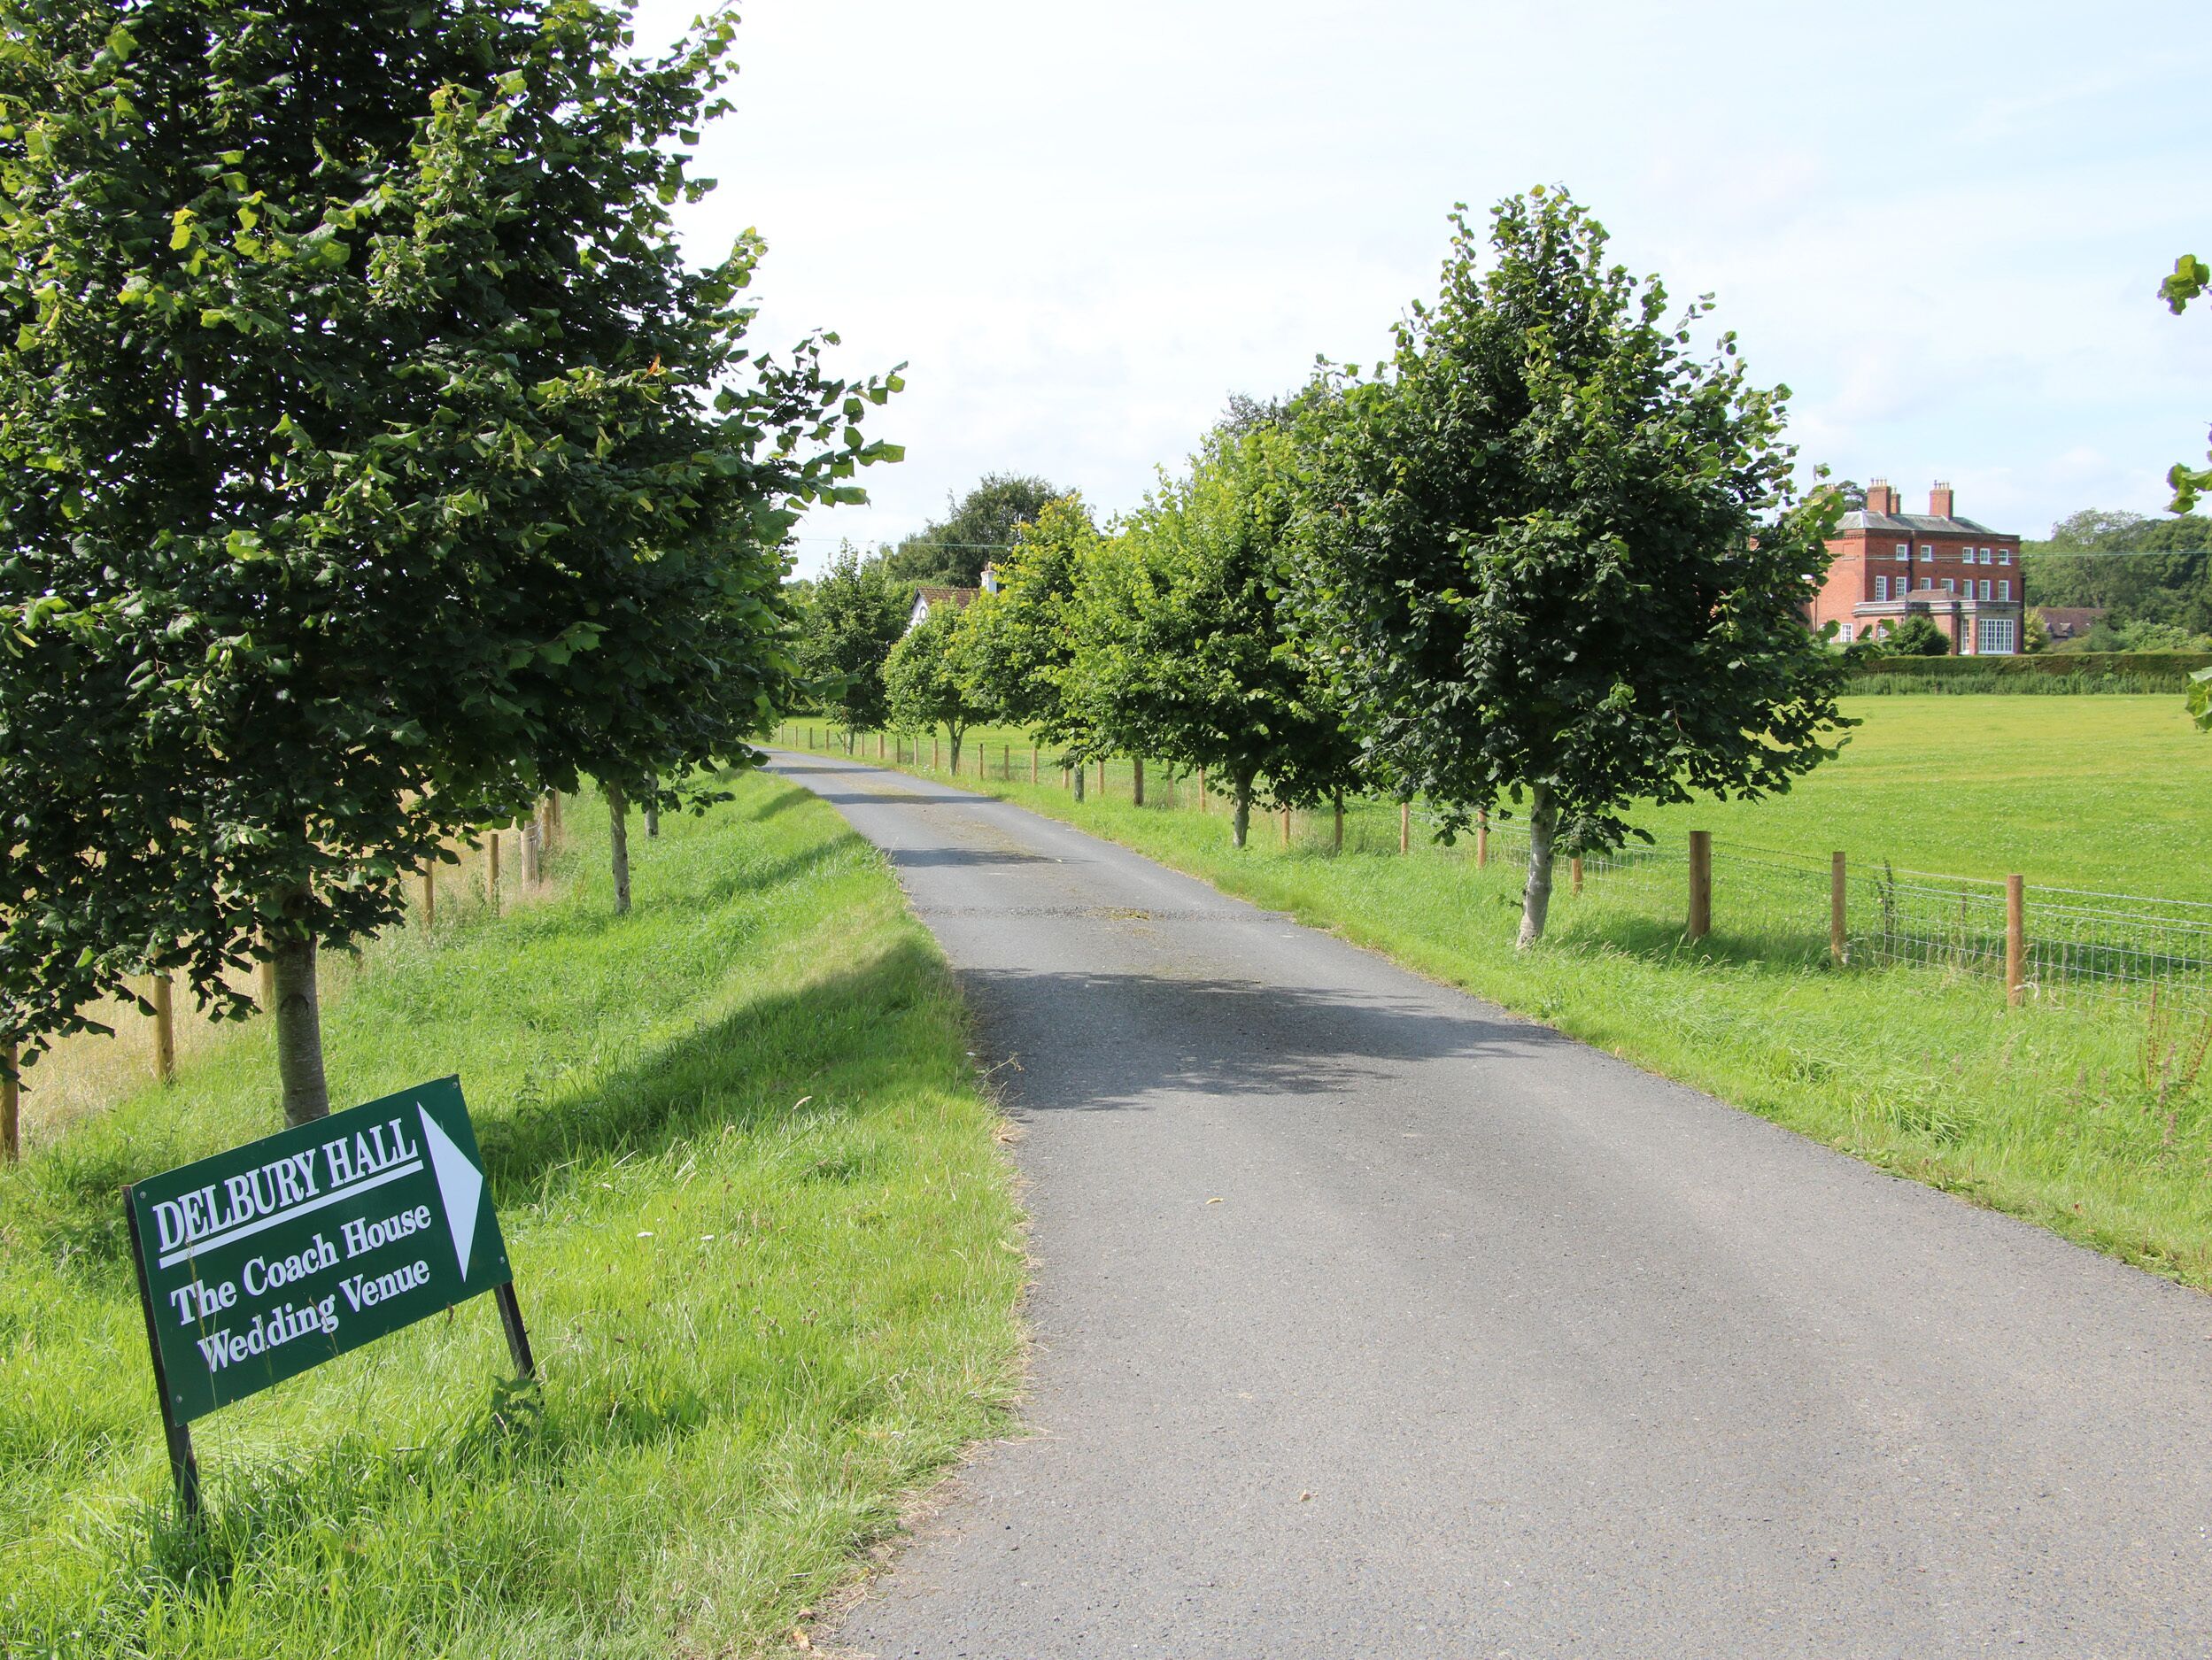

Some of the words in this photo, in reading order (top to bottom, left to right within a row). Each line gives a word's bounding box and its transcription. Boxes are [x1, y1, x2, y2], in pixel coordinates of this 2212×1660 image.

[152, 1149, 319, 1253] DELBURY
[323, 1118, 418, 1187] HALL
[171, 1279, 237, 1326] The
[244, 1233, 339, 1297] Coach
[341, 1205, 431, 1259] House
[198, 1293, 339, 1373] Wedding
[340, 1260, 430, 1313] Venue
